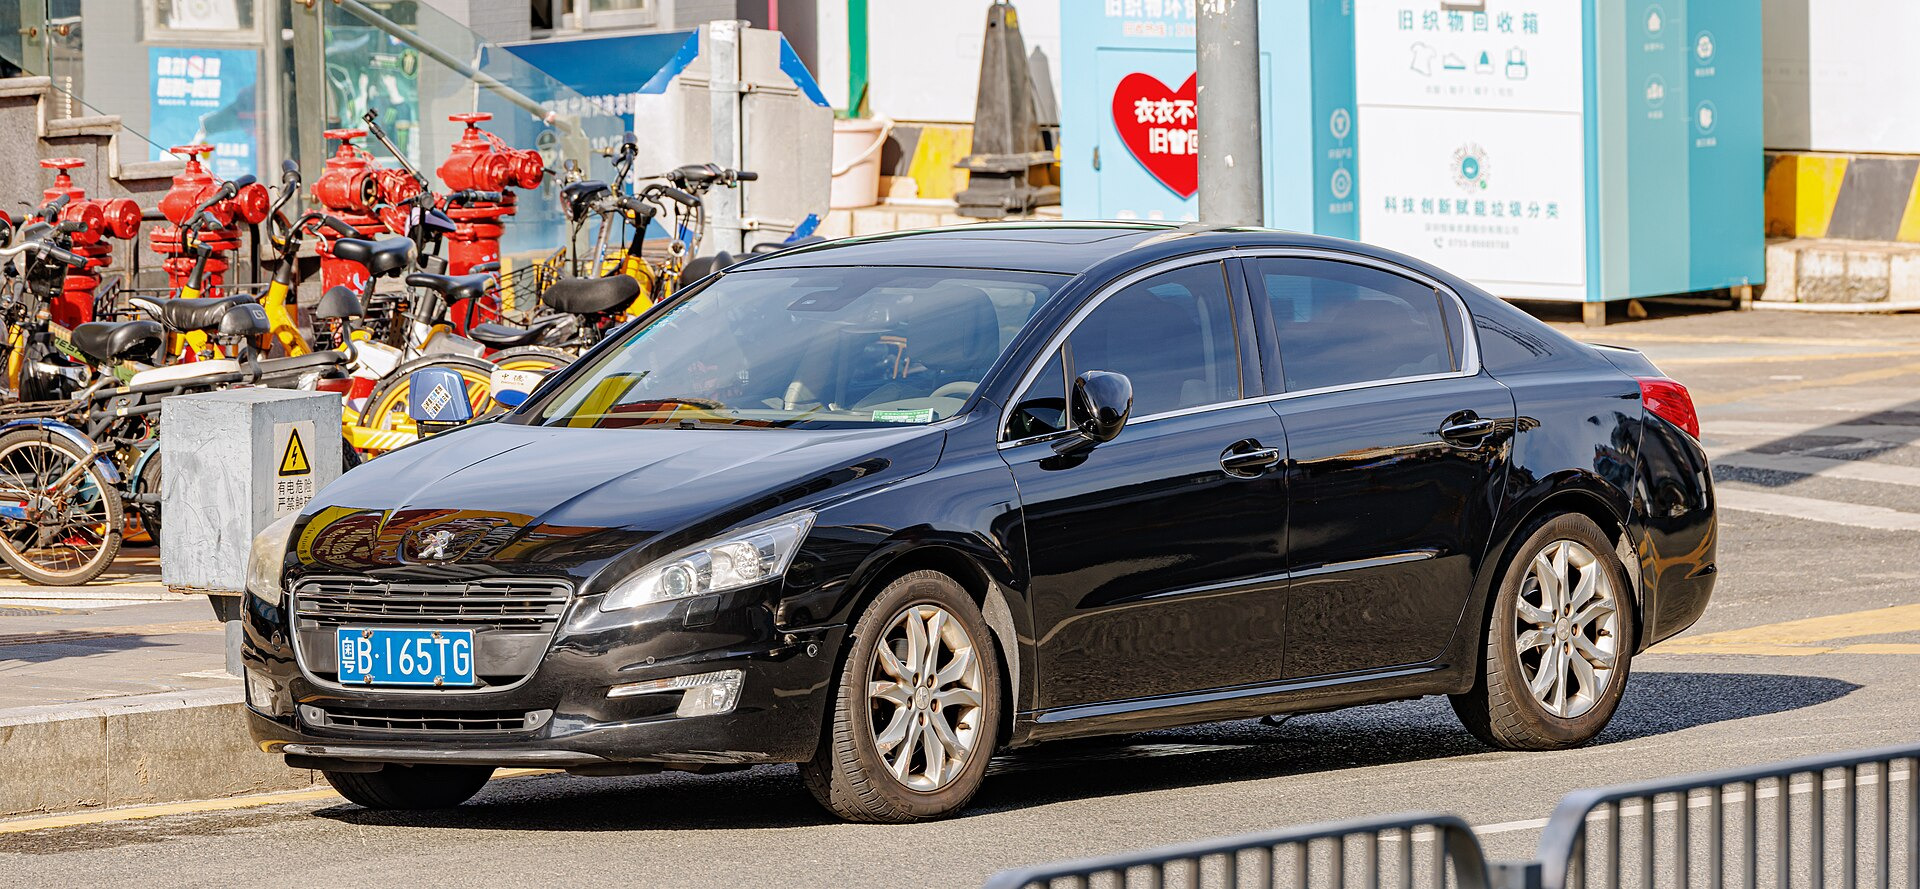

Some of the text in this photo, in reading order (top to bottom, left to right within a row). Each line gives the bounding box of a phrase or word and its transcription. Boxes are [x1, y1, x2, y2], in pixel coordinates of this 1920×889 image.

[1398, 9, 1538, 34] 旧织物回收箱
[1134, 97, 1197, 125] 衣衣不
[1384, 196, 1559, 219] 科技创新赋能垃圾分类
[277, 479, 312, 496] 有电危险
[341, 637, 470, 676] 粤B·165TG
